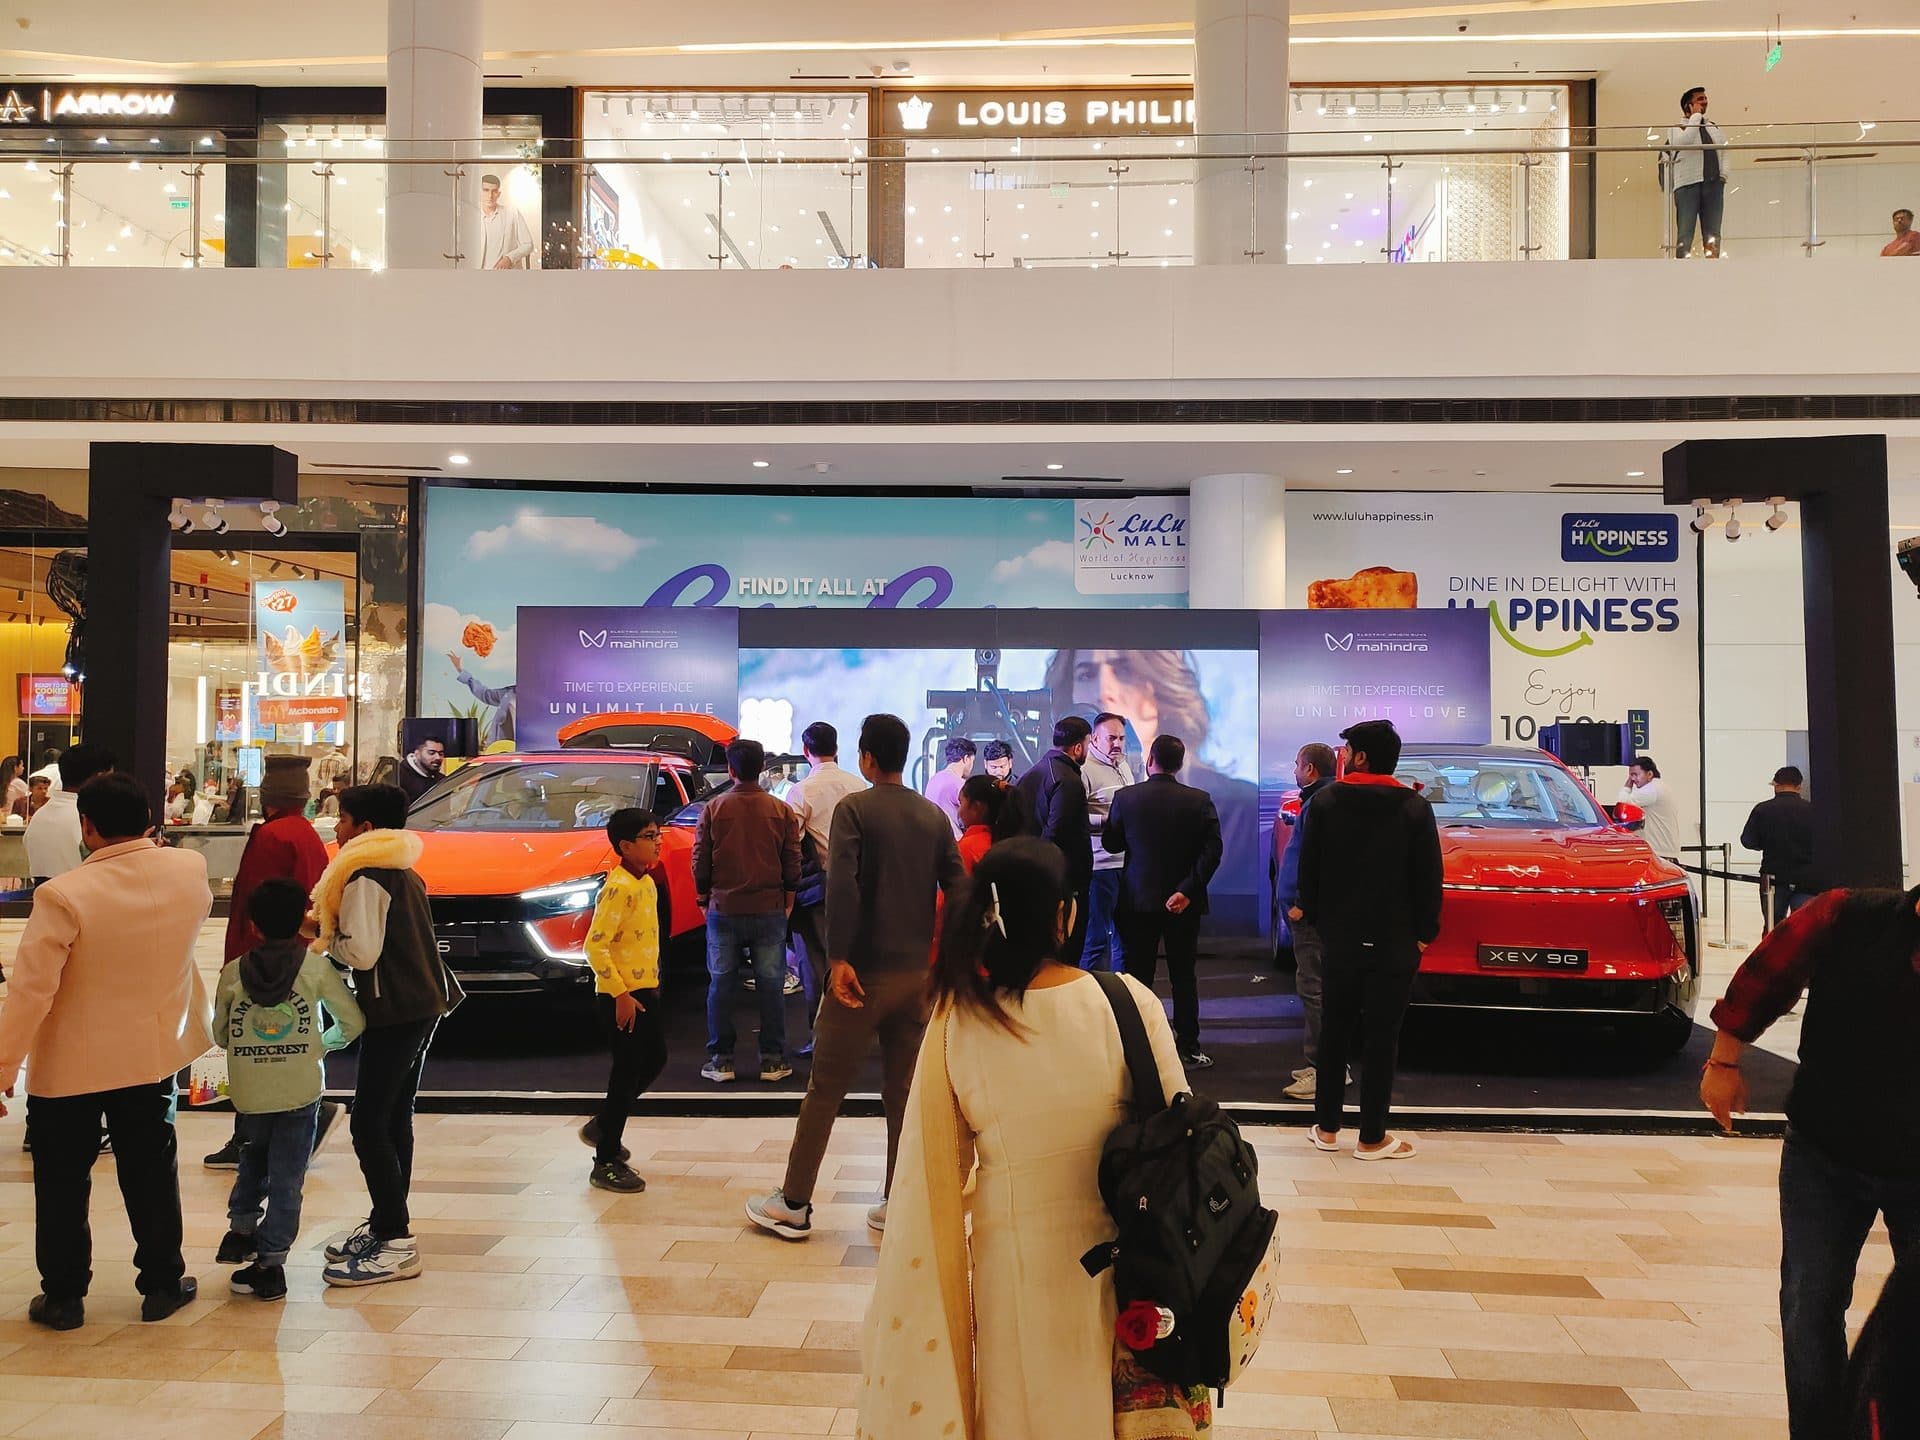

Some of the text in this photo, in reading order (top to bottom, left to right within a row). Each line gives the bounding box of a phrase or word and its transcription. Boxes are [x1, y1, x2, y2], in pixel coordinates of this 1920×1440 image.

[56, 92, 175, 115] ARROW
[958, 101, 1066, 125] LOUIS
[1118, 513, 1186, 533] LuLu
[1313, 512, 1434, 522] www.luluhappiness.in
[1572, 519, 1600, 528] LuLu
[1124, 536, 1186, 546] MALL
[1571, 530, 1668, 556] HAPPINESS
[1080, 554, 1107, 562] World
[1114, 554, 1123, 562] of
[738, 577, 788, 595] FIND
[793, 577, 815, 595] IT
[818, 577, 856, 595] ALL
[862, 578, 888, 596] AT
[1449, 576, 1676, 591] DINE IN DELIGHT WITH
[610, 639, 679, 649] mahindra
[1357, 642, 1428, 652] mahindra
[564, 682, 693, 692] TIME TO EXPERIENCE
[1311, 686, 1445, 696] TIME TO EXPERIENCE
[1524, 669, 1596, 713] Enjoy
[288, 706, 339, 716] McDonald's
[550, 702, 714, 714] UNLIMIT LOVE
[1295, 706, 1466, 718] UNLIMIT LOVE
[1489, 950, 1538, 962] XEV
[233, 1043, 309, 1056] PINECREST
